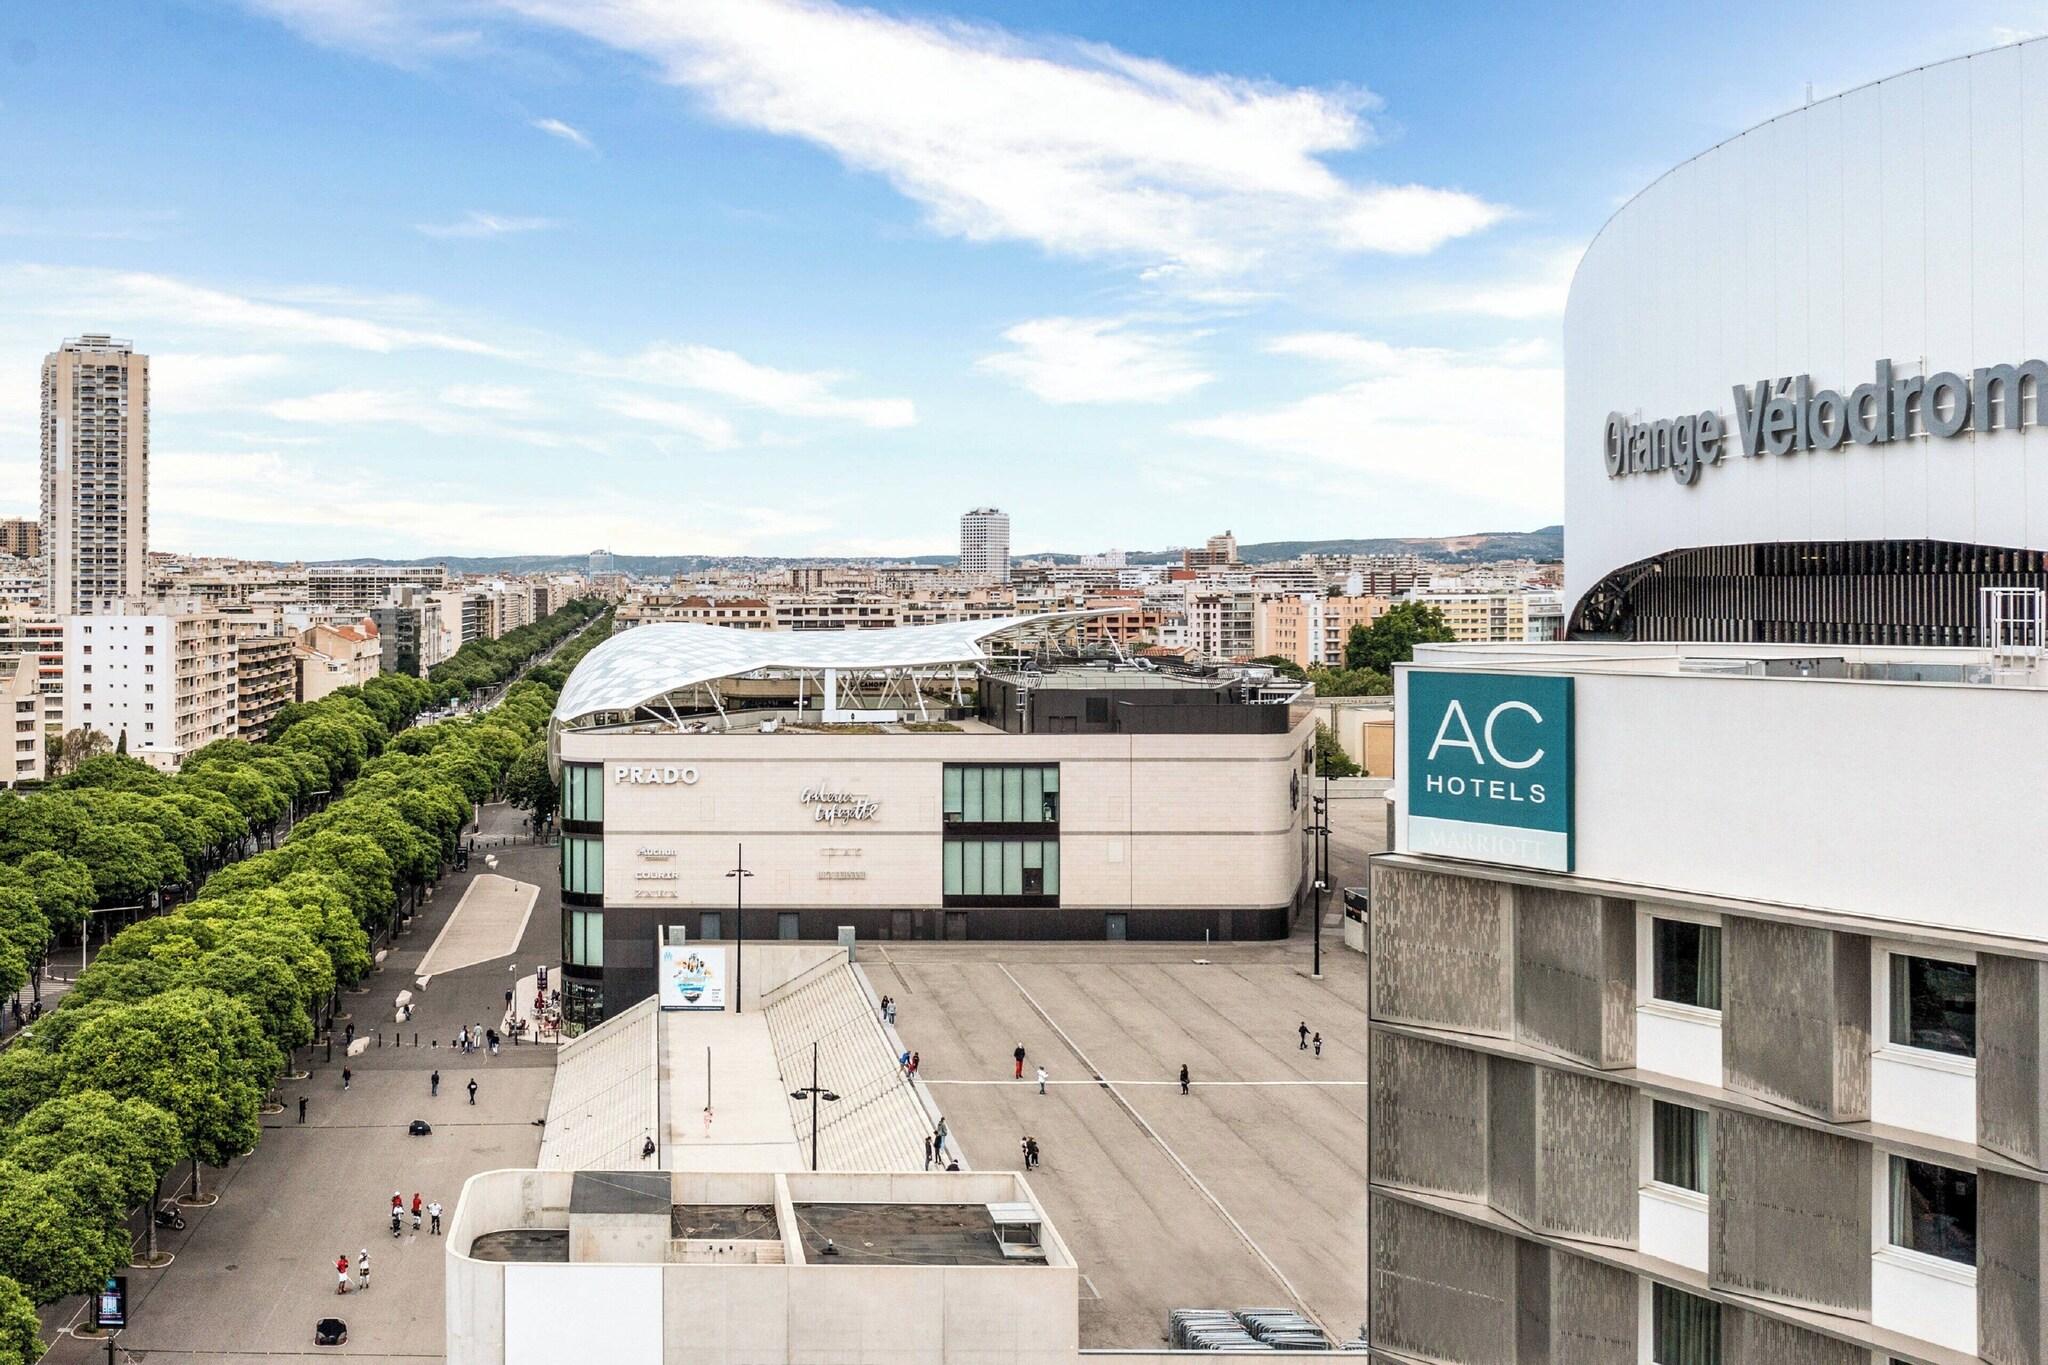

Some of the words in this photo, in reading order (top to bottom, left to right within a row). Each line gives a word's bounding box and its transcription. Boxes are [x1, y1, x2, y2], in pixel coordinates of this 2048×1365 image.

[1604, 410, 1723, 485] Orange
[1427, 699, 1545, 769] AC
[615, 766, 700, 785] PRADO
[1426, 774, 1546, 804] HOTELS
[1430, 830, 1546, 861] MARRIOTT
